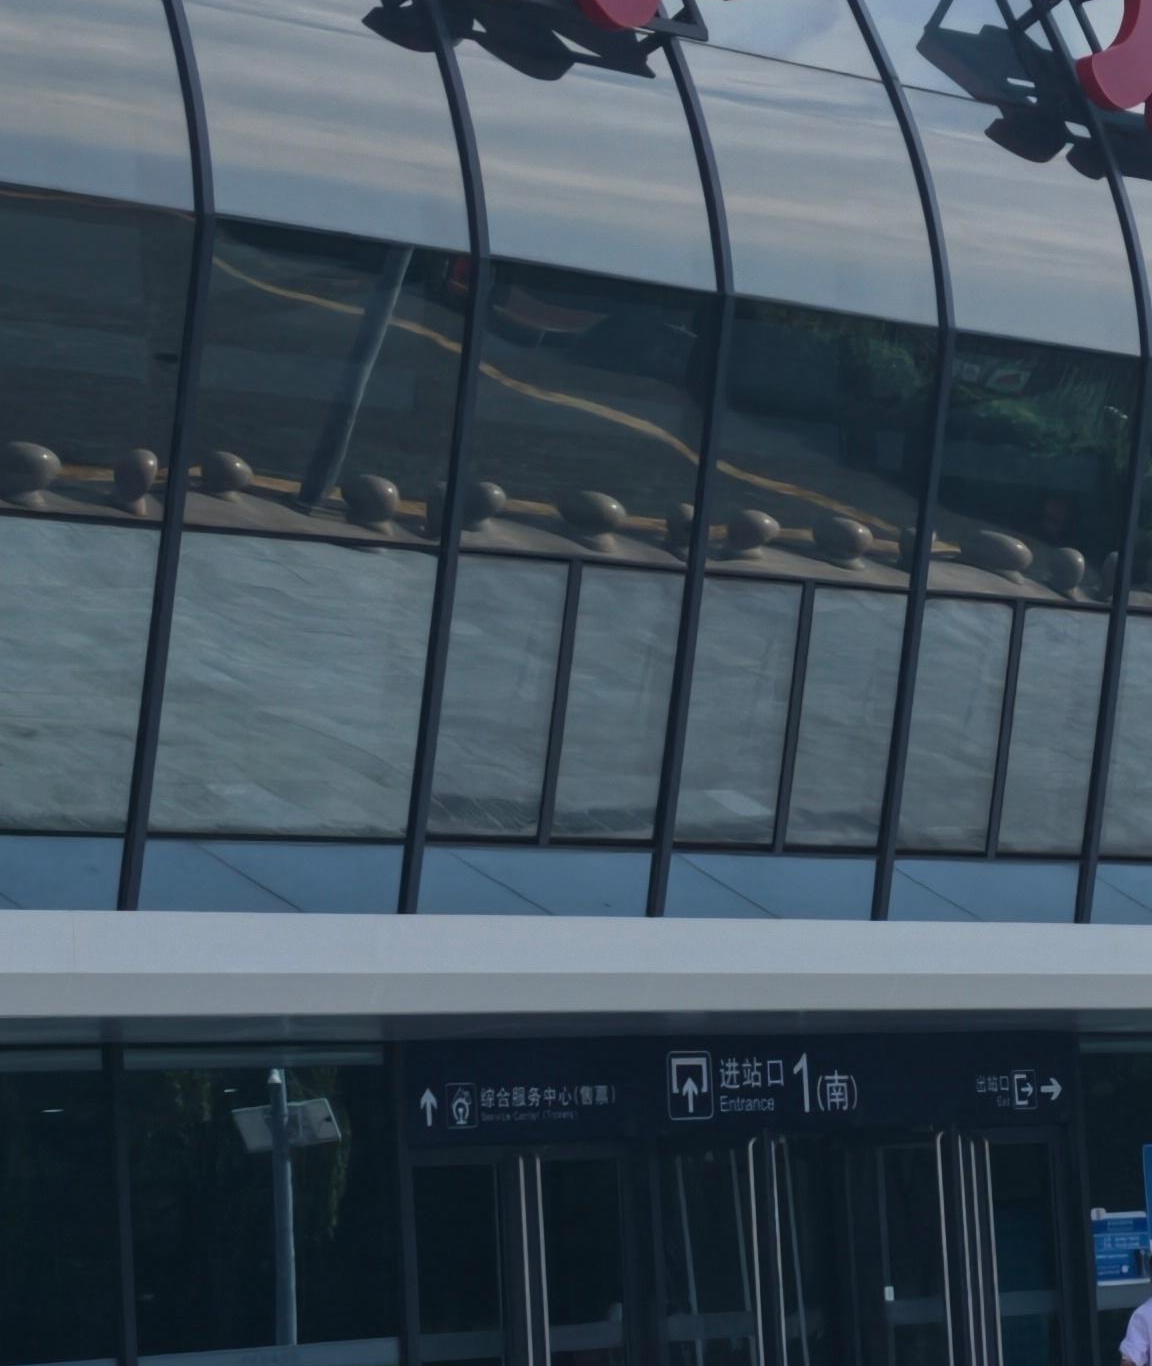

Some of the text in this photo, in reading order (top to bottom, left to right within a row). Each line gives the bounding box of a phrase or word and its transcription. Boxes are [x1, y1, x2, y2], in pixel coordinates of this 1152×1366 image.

[719, 1056, 785, 1089] 进站口
[975, 1074, 1010, 1093] 出站口
[719, 1094, 776, 1113] Entrance
